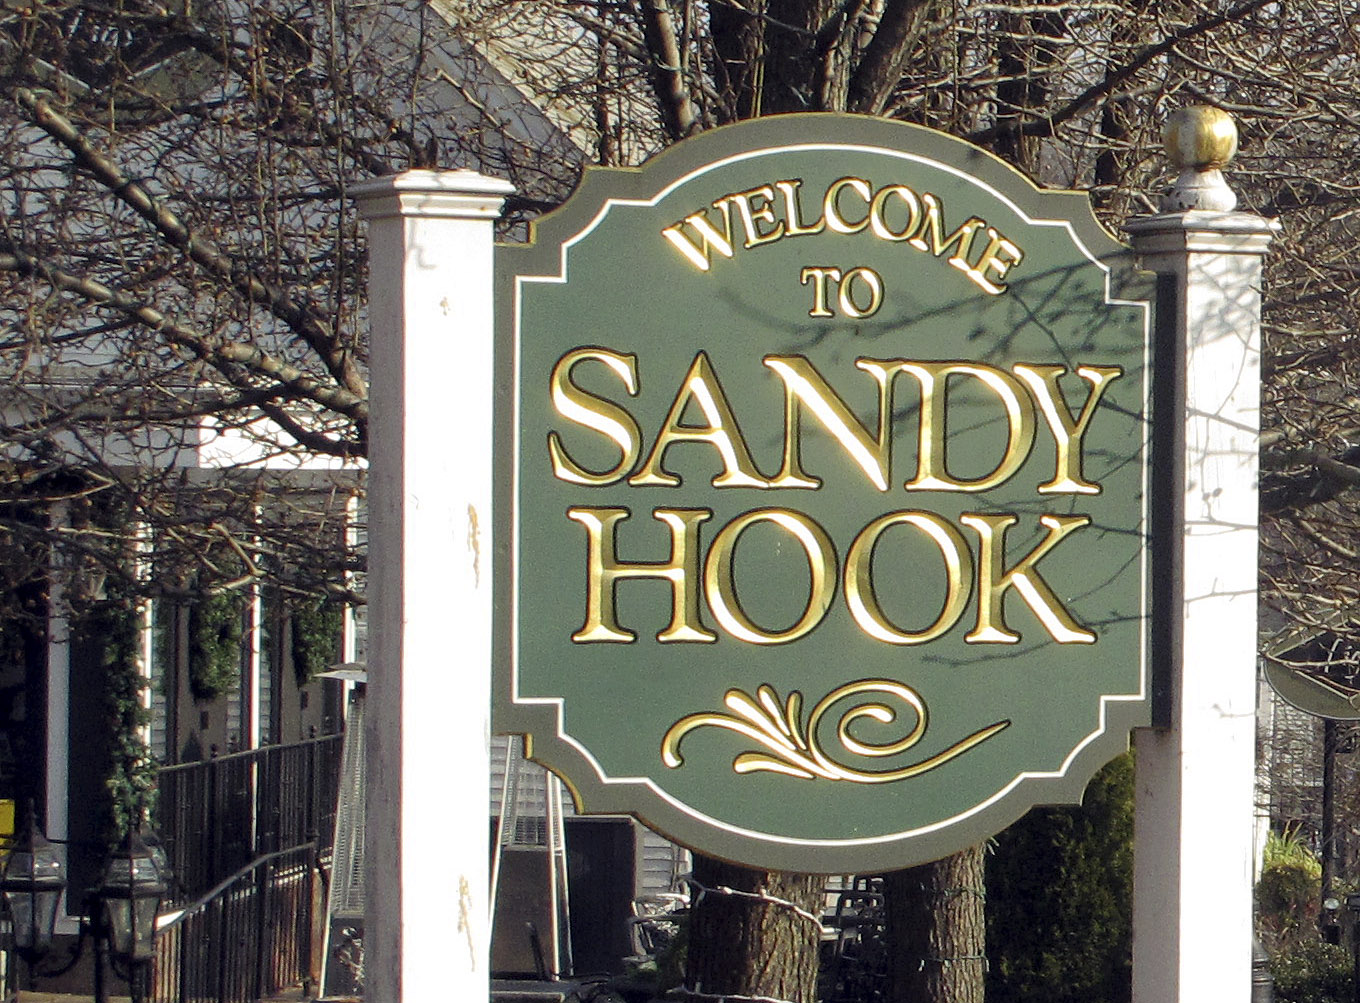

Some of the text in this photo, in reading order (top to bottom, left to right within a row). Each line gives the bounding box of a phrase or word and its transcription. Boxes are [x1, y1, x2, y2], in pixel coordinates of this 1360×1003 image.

[661, 176, 1024, 296] WELCOME
[801, 267, 885, 318] TO
[547, 345, 1123, 494] SANDY
[567, 506, 1098, 645] HOOK
